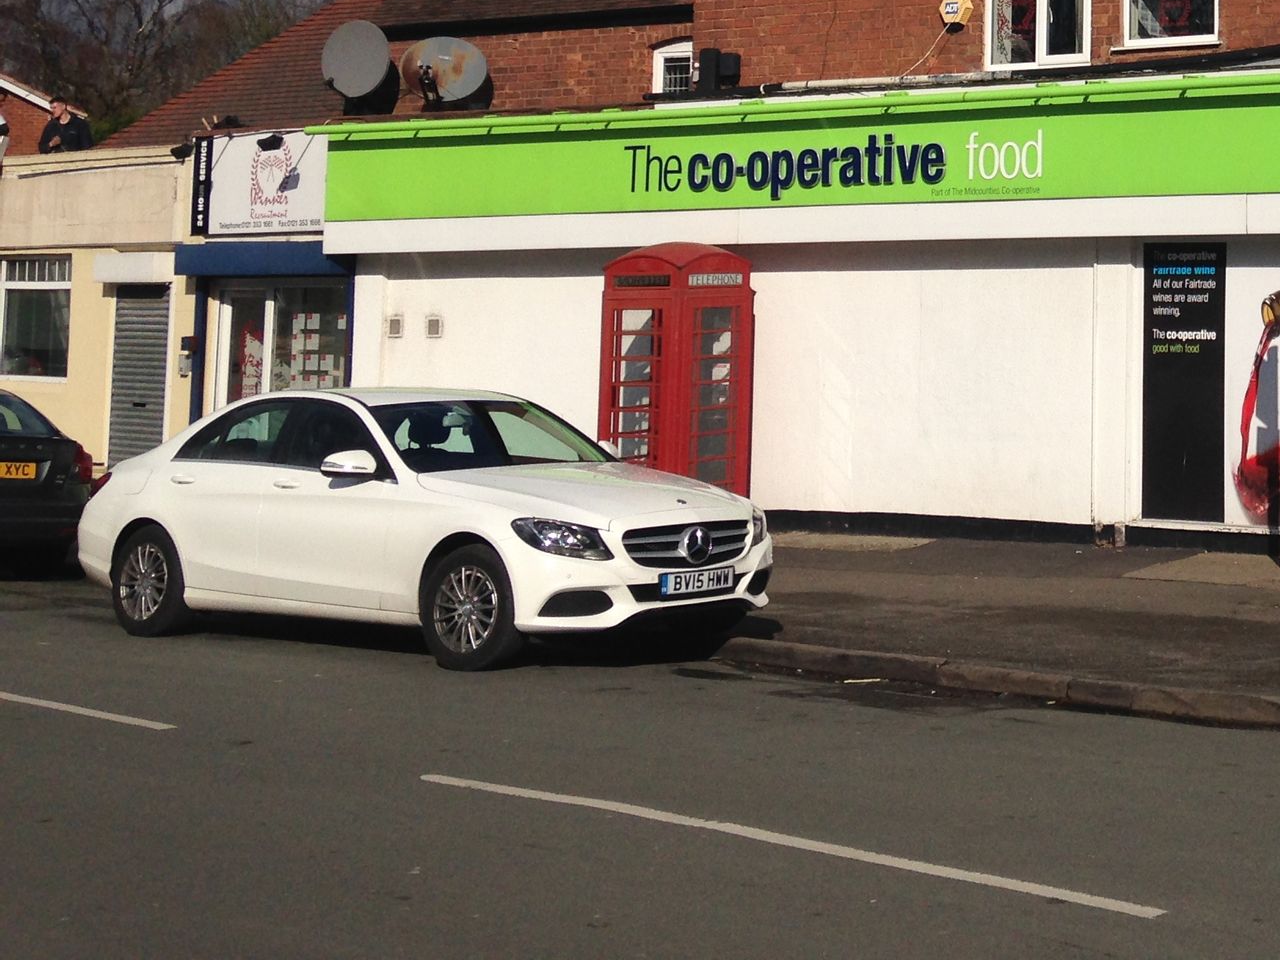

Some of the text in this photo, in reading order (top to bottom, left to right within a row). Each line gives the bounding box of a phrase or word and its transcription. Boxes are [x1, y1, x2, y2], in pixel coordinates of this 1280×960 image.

[945, 3, 959, 14] ADT
[624, 128, 1042, 201] The co-operative food
[196, 140, 208, 227] 24 HOUR SERVICE
[251, 180, 288, 207] Winner
[931, 188, 943, 197] Part
[944, 187, 951, 196] of
[952, 186, 963, 196] The
[250, 208, 288, 220] Recruitment
[1167, 250, 1217, 262] co-operative
[1153, 265, 1216, 275] Fairtrade wine
[691, 274, 740, 286] TELEPHONE
[1152, 278, 1217, 289] All of our Fairtrade
[1152, 293, 1209, 303] wines are award
[1152, 328, 1217, 342] The co-operative
[1152, 344, 1200, 355] good with food
[5, 464, 30, 476] XYC
[673, 569, 730, 591] BV15 HWW
